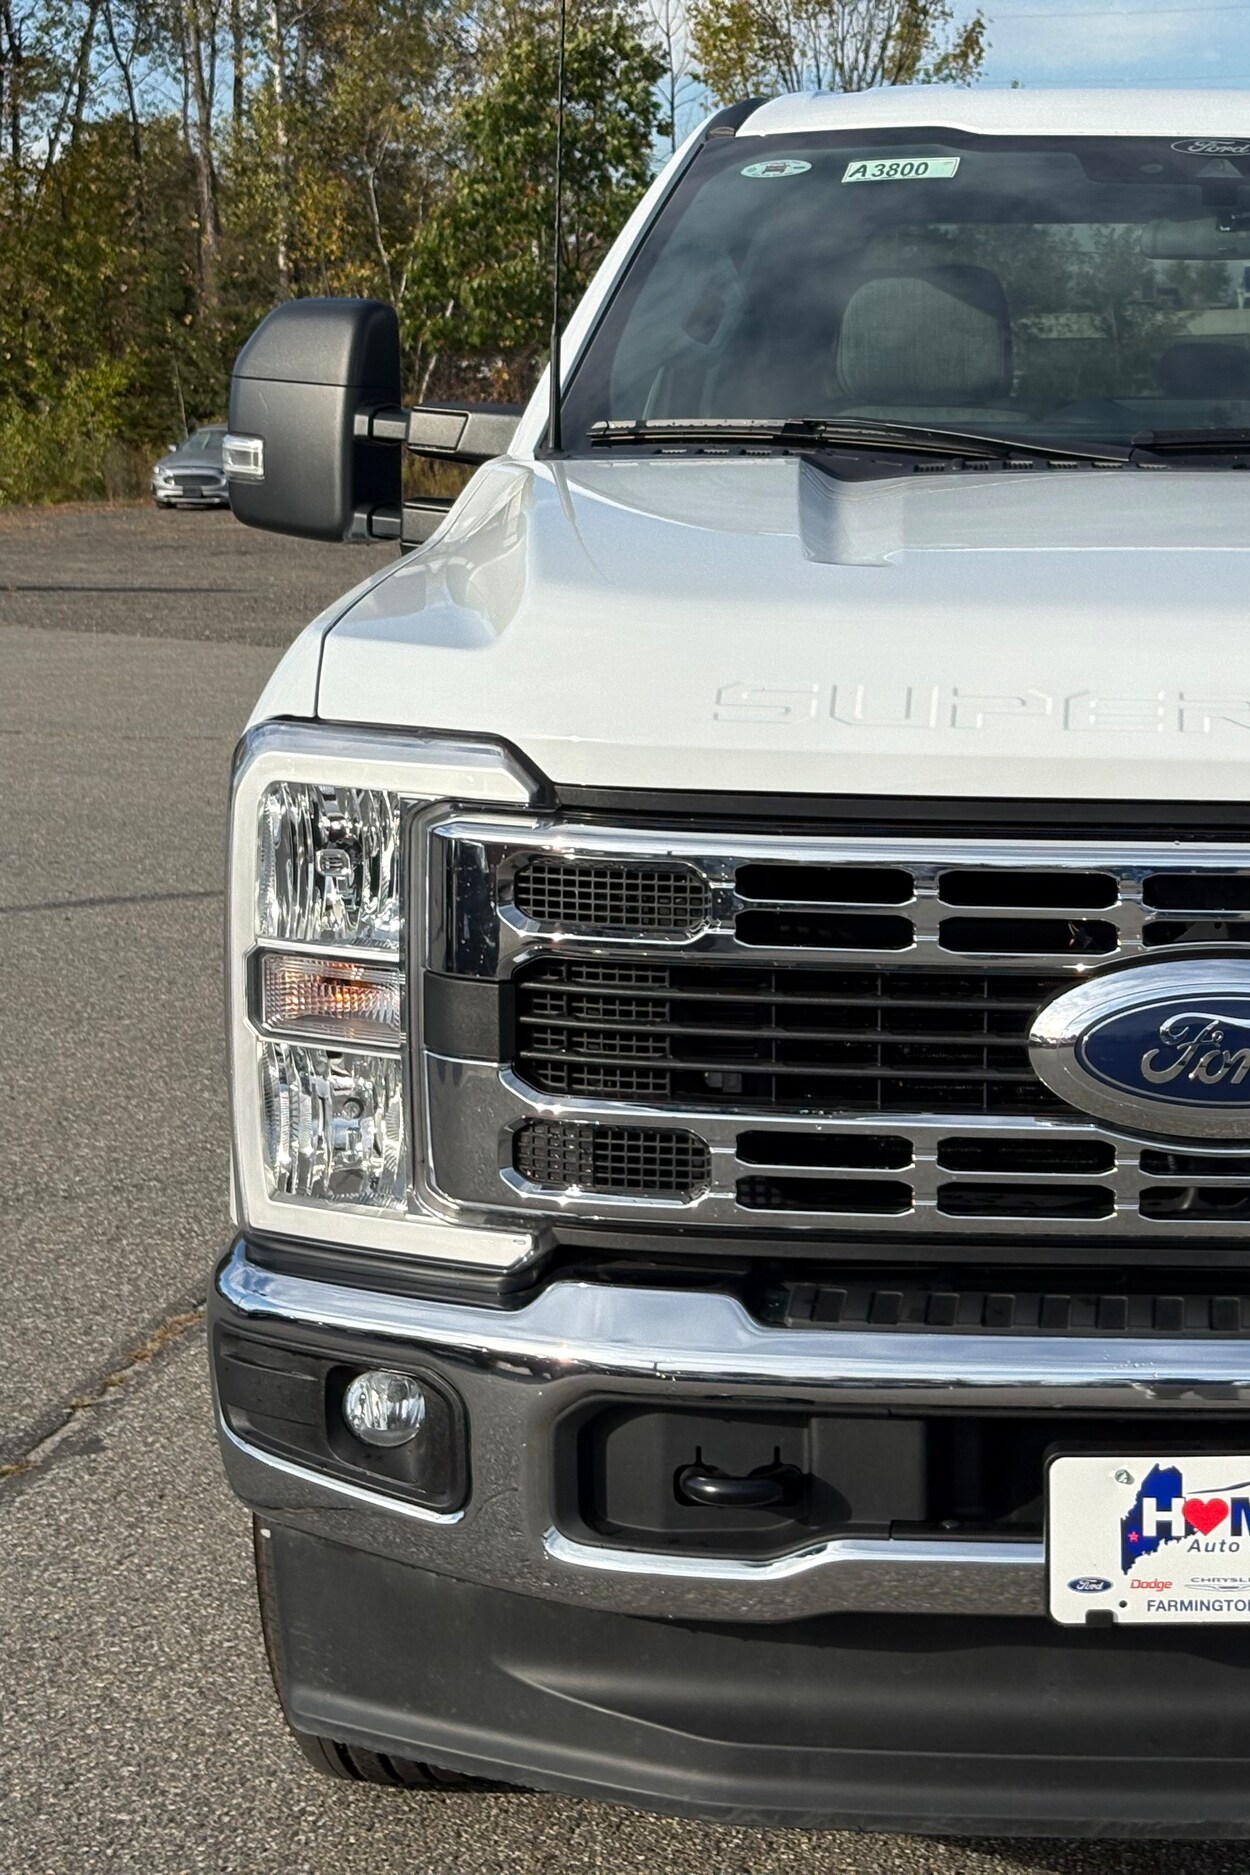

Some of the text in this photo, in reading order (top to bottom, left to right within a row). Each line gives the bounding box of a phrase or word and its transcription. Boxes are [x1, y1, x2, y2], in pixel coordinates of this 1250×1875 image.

[1188, 141, 1250, 153] Ford
[848, 162, 929, 178] A3800
[1187, 1539, 1240, 1554] Auto
[1076, 1578, 1104, 1591] Ford
[1130, 1579, 1173, 1592] Dodge
